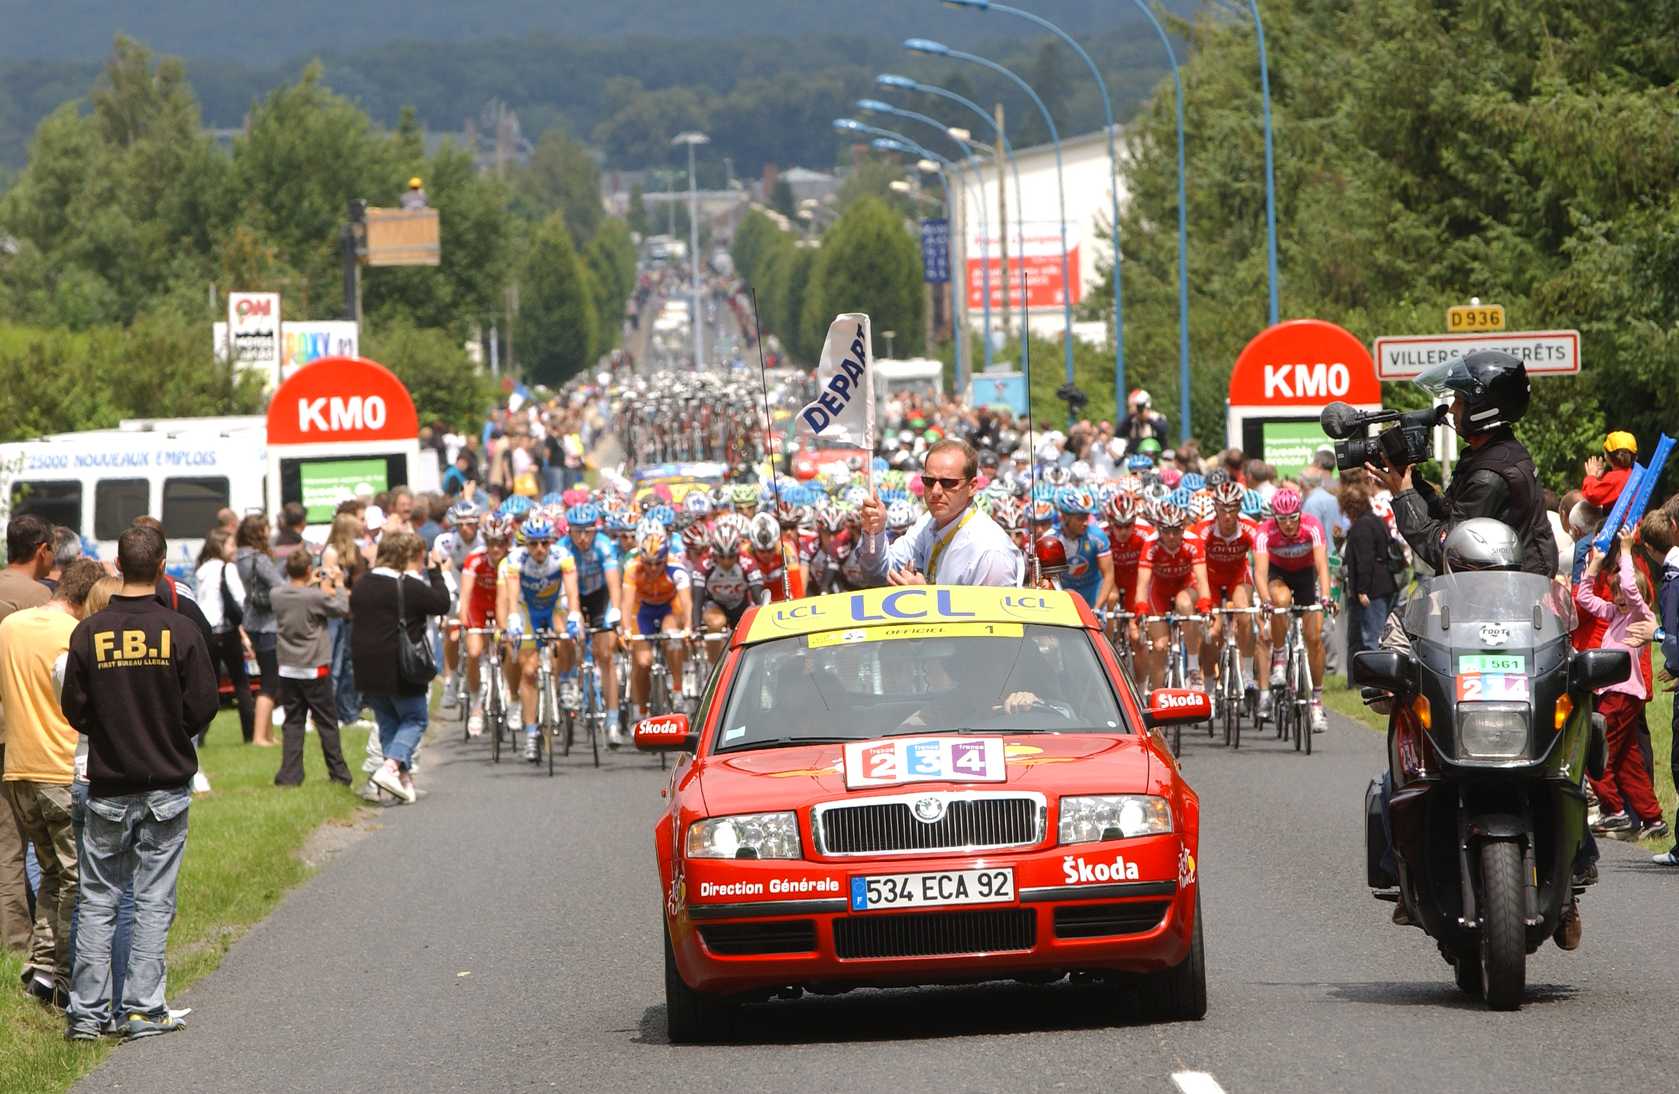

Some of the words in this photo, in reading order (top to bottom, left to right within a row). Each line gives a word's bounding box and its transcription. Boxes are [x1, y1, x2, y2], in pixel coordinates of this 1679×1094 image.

[1466, 311, 1500, 326] 936
[75, 453, 149, 468] NOUVEAUX
[156, 451, 216, 467] EMPLOIS
[850, 589, 975, 622] LCL
[1005, 595, 1054, 609] LCL
[776, 604, 824, 622] LCL
[1491, 660, 1519, 669] 561
[870, 755, 897, 777] 2
[915, 750, 941, 773] 3
[956, 750, 985, 771] 4
[1062, 855, 1139, 884] Škoda
[700, 881, 763, 897] Direction
[769, 878, 839, 893] Générale
[866, 877, 914, 904] 534
[921, 874, 969, 901] ECA
[977, 871, 1009, 898] 92
